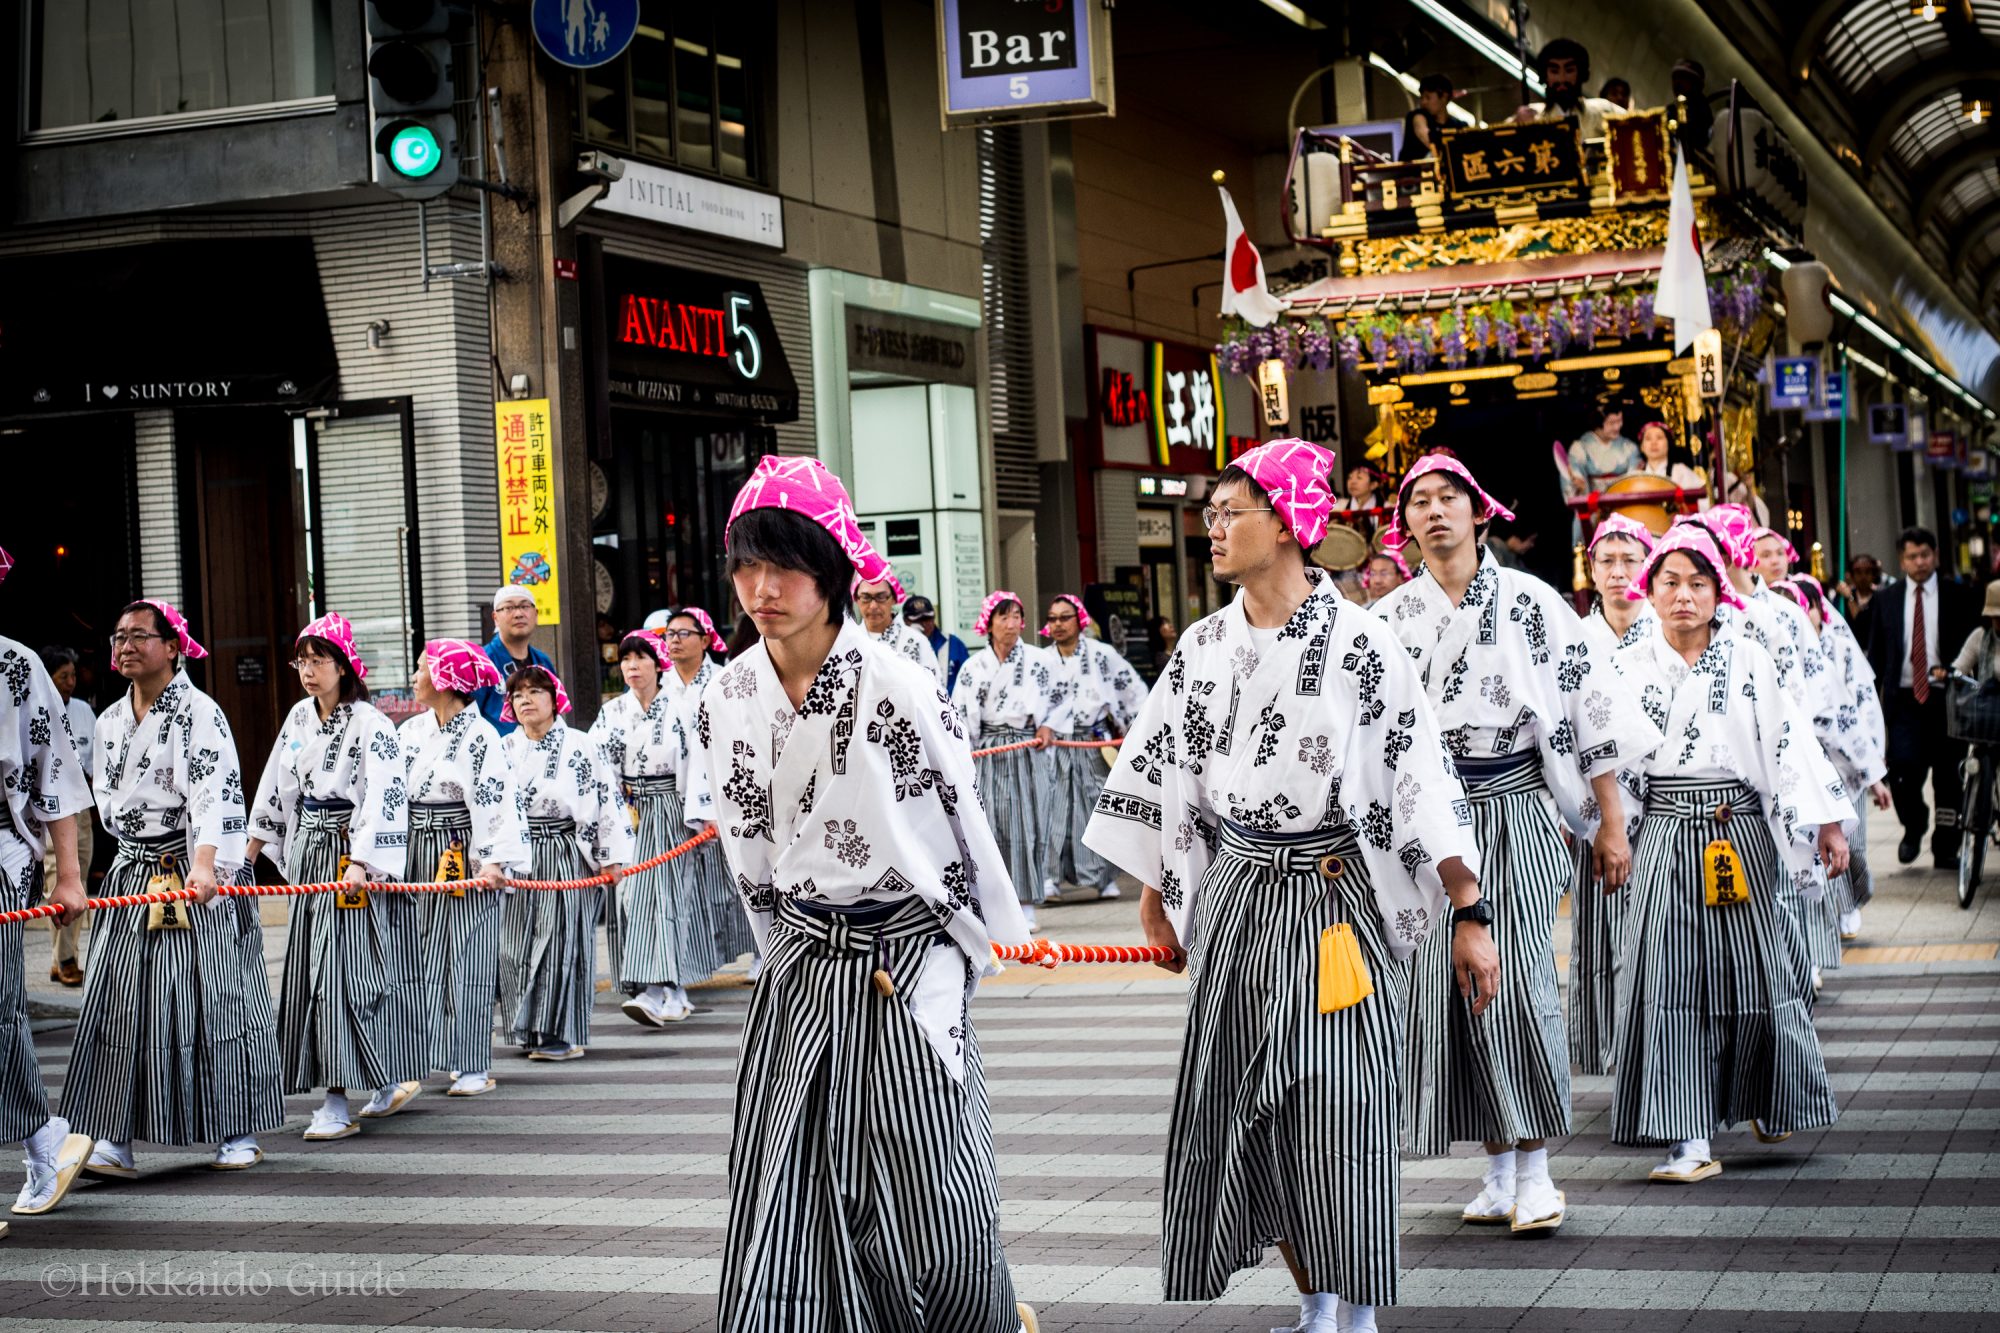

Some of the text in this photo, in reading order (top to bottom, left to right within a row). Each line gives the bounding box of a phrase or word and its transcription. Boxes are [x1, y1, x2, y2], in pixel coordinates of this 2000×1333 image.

[968, 30, 1066, 68] Bar
[1009, 76, 1030, 99] 5
[629, 178, 694, 213] INITIAL
[761, 212, 775, 232] 2F
[622, 291, 762, 380] AVANTI 5
[85, 382, 231, 402] I SUNTORY
[637, 381, 682, 402] WHISKY
[1166, 370, 1214, 450] 王将
[503, 414, 530, 537] 通行禁止
[529, 412, 549, 534] 許可車両以外
